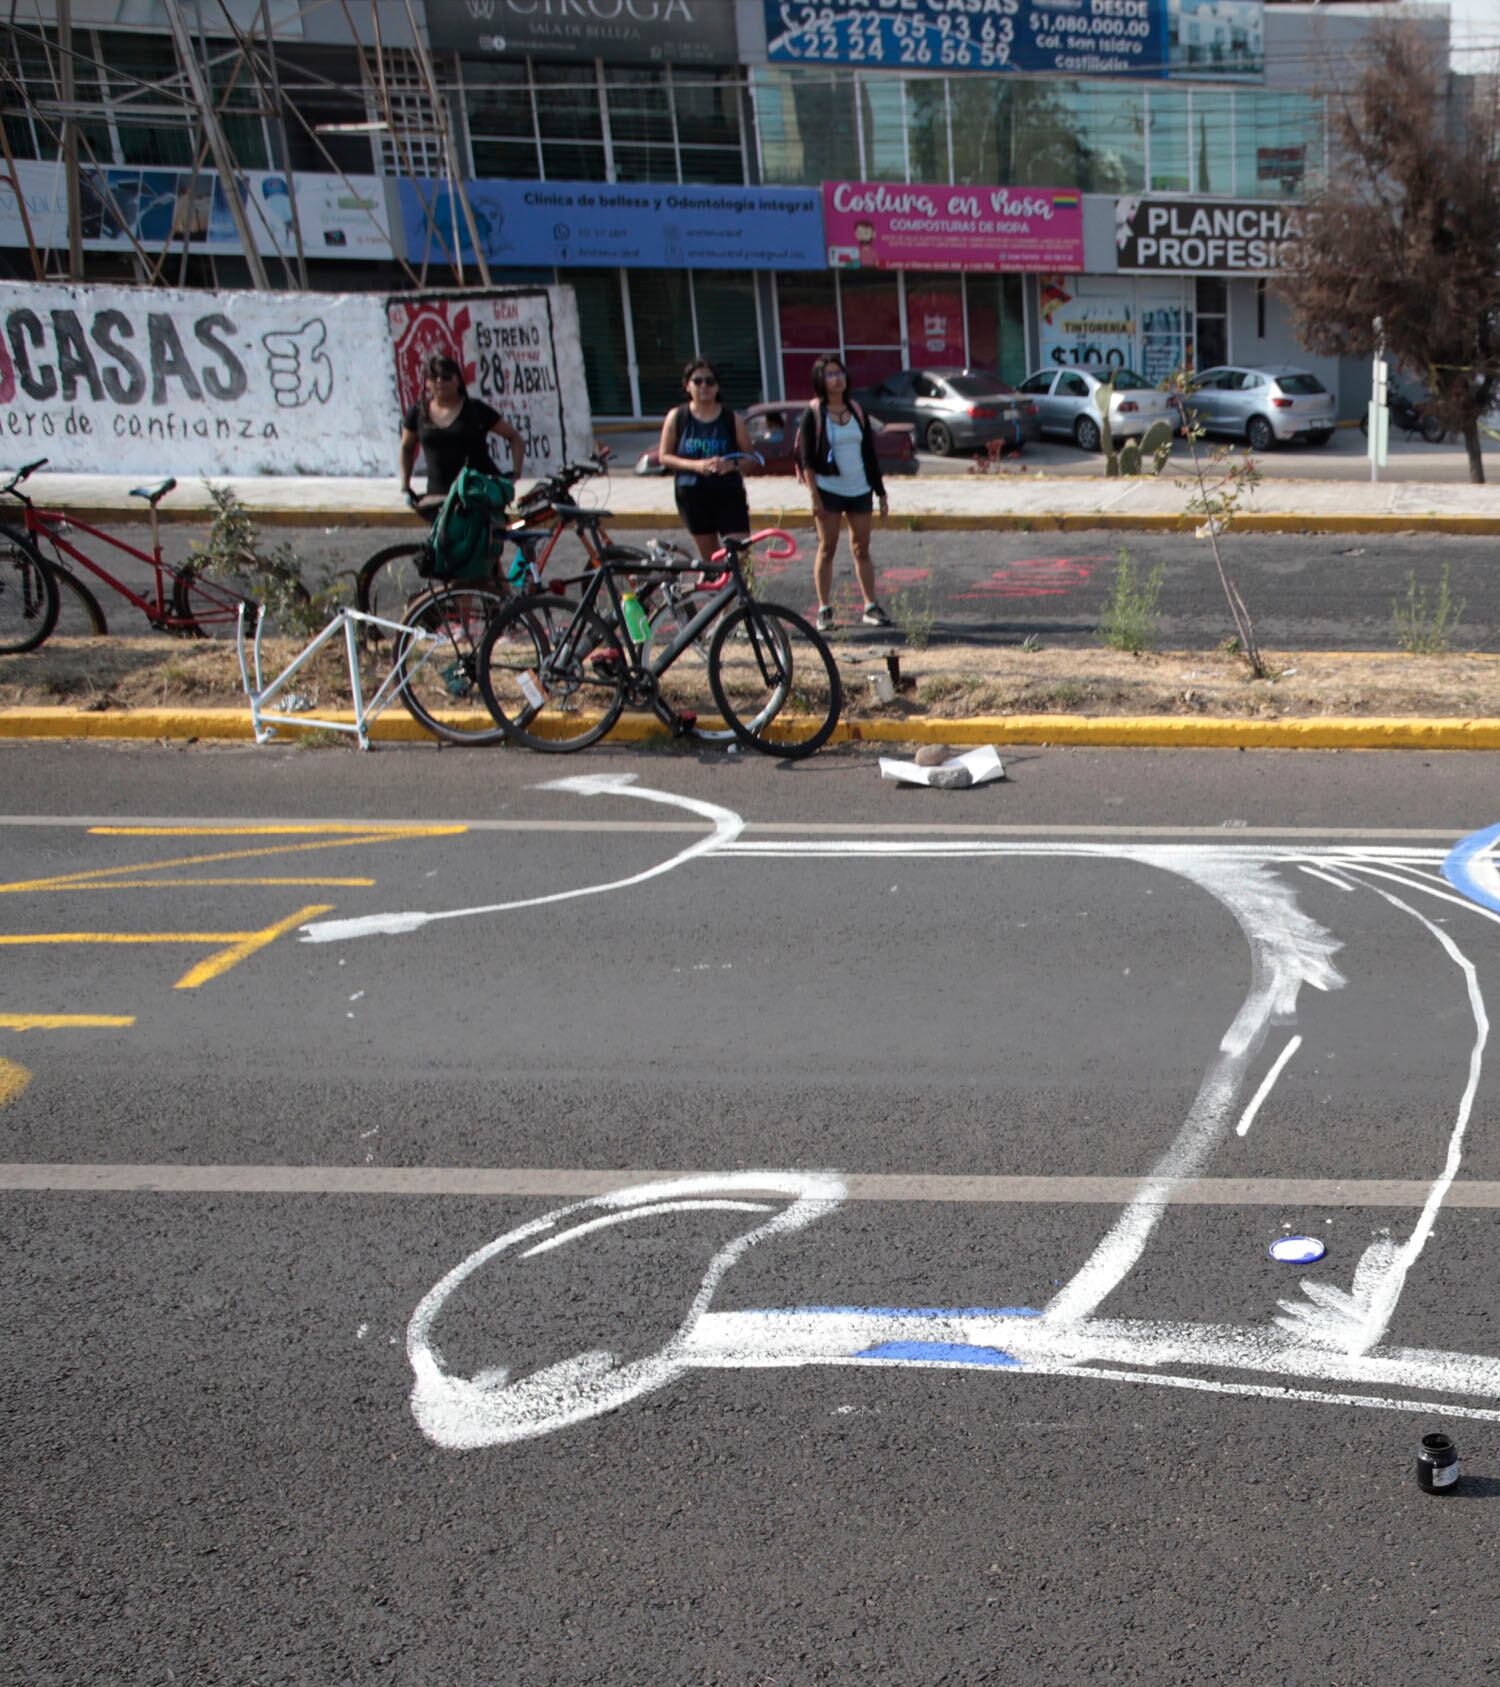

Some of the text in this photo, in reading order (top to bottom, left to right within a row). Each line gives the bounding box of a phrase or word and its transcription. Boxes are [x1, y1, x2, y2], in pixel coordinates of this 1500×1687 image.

[801, 8, 1014, 43] 22 22 65 93 63
[1091, 0, 1149, 18] DESDE
[803, 34, 1011, 67] 22 24 26 56 59
[578, 194, 596, 208] de
[599, 194, 649, 209] belleza
[653, 199, 662, 212] y
[758, 198, 814, 214] integral
[833, 183, 1054, 220] Costura en Rosa
[889, 218, 1030, 234] COMPOSTURAS DE ROPA
[1148, 206, 1322, 238] PLANCHA
[1136, 236, 1309, 269] PROFESIO
[480, 353, 505, 396] 28
[513, 363, 557, 395] ABRIL
[0, 407, 279, 440] ero de confianza
[505, 432, 550, 460] Pdro
